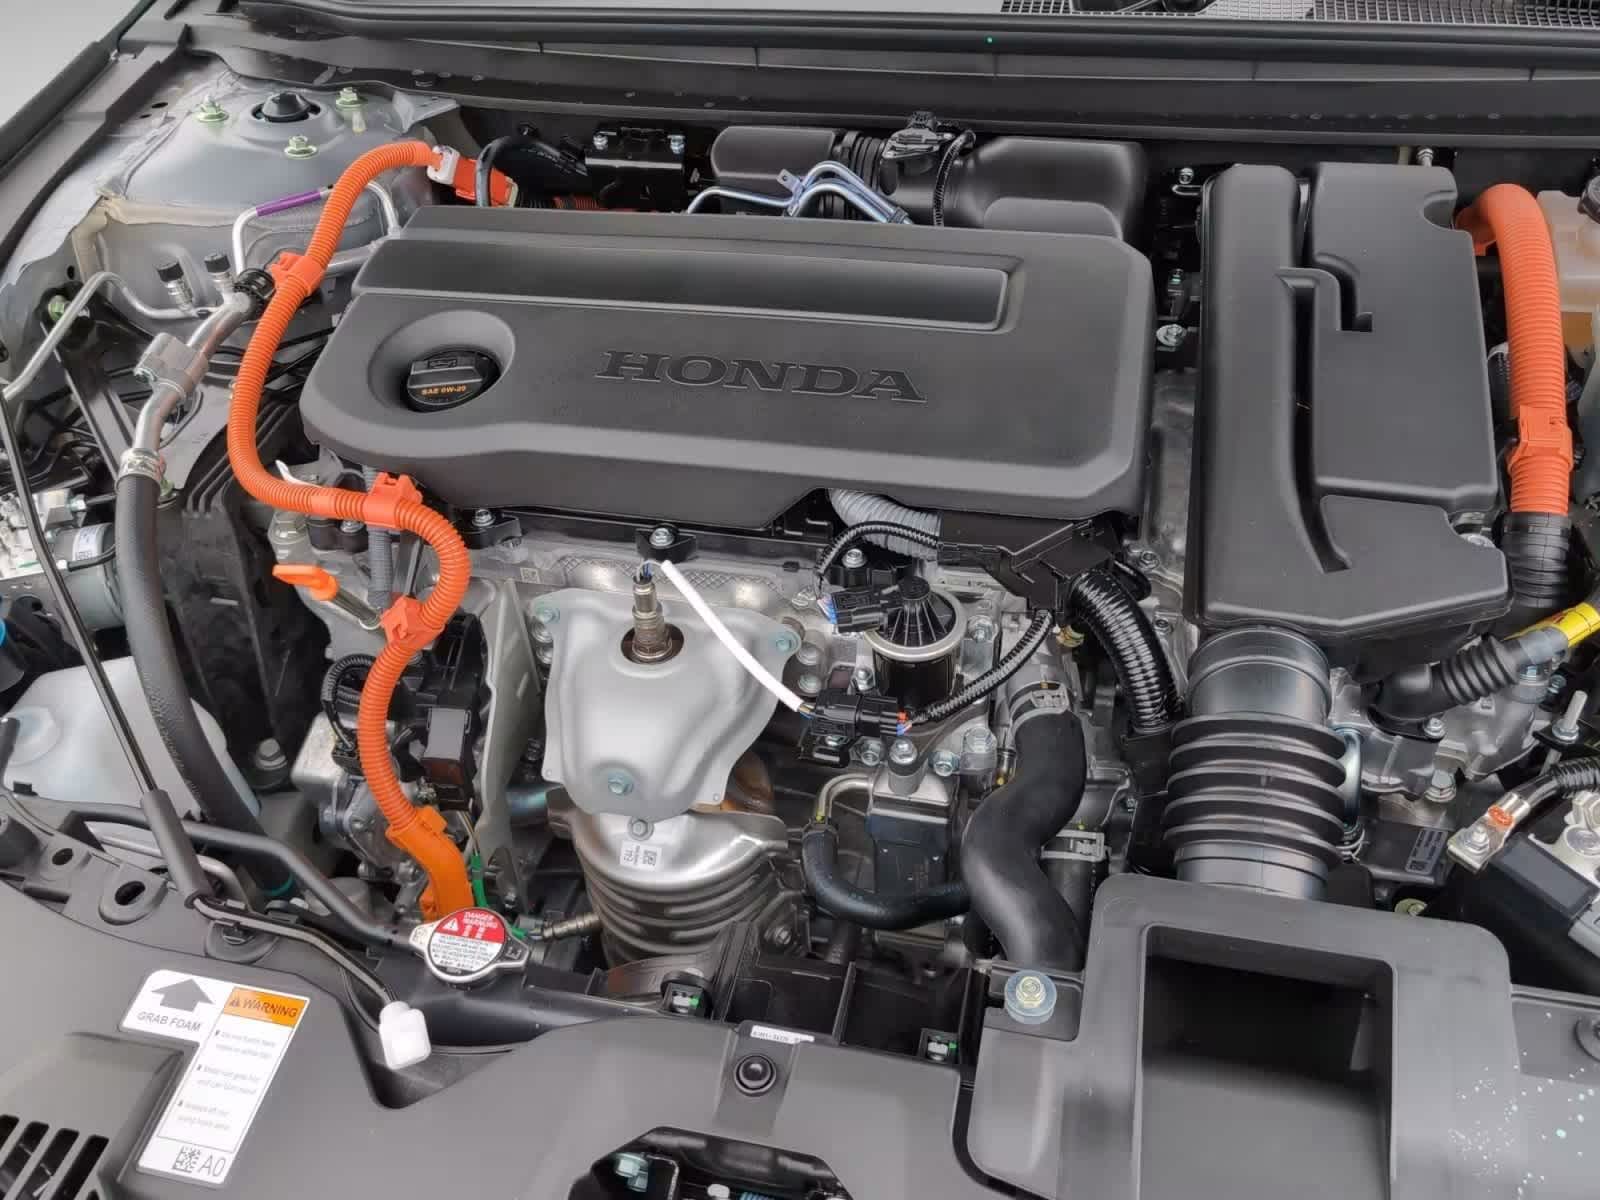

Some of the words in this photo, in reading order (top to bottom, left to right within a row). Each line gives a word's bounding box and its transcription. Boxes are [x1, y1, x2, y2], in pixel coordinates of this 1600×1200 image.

[594, 350, 928, 403] HONDA
[421, 387, 439, 395] SAE
[242, 999, 298, 1018] WARNING
[136, 1011, 169, 1025] GRAB
[170, 1017, 202, 1032] FOAM
